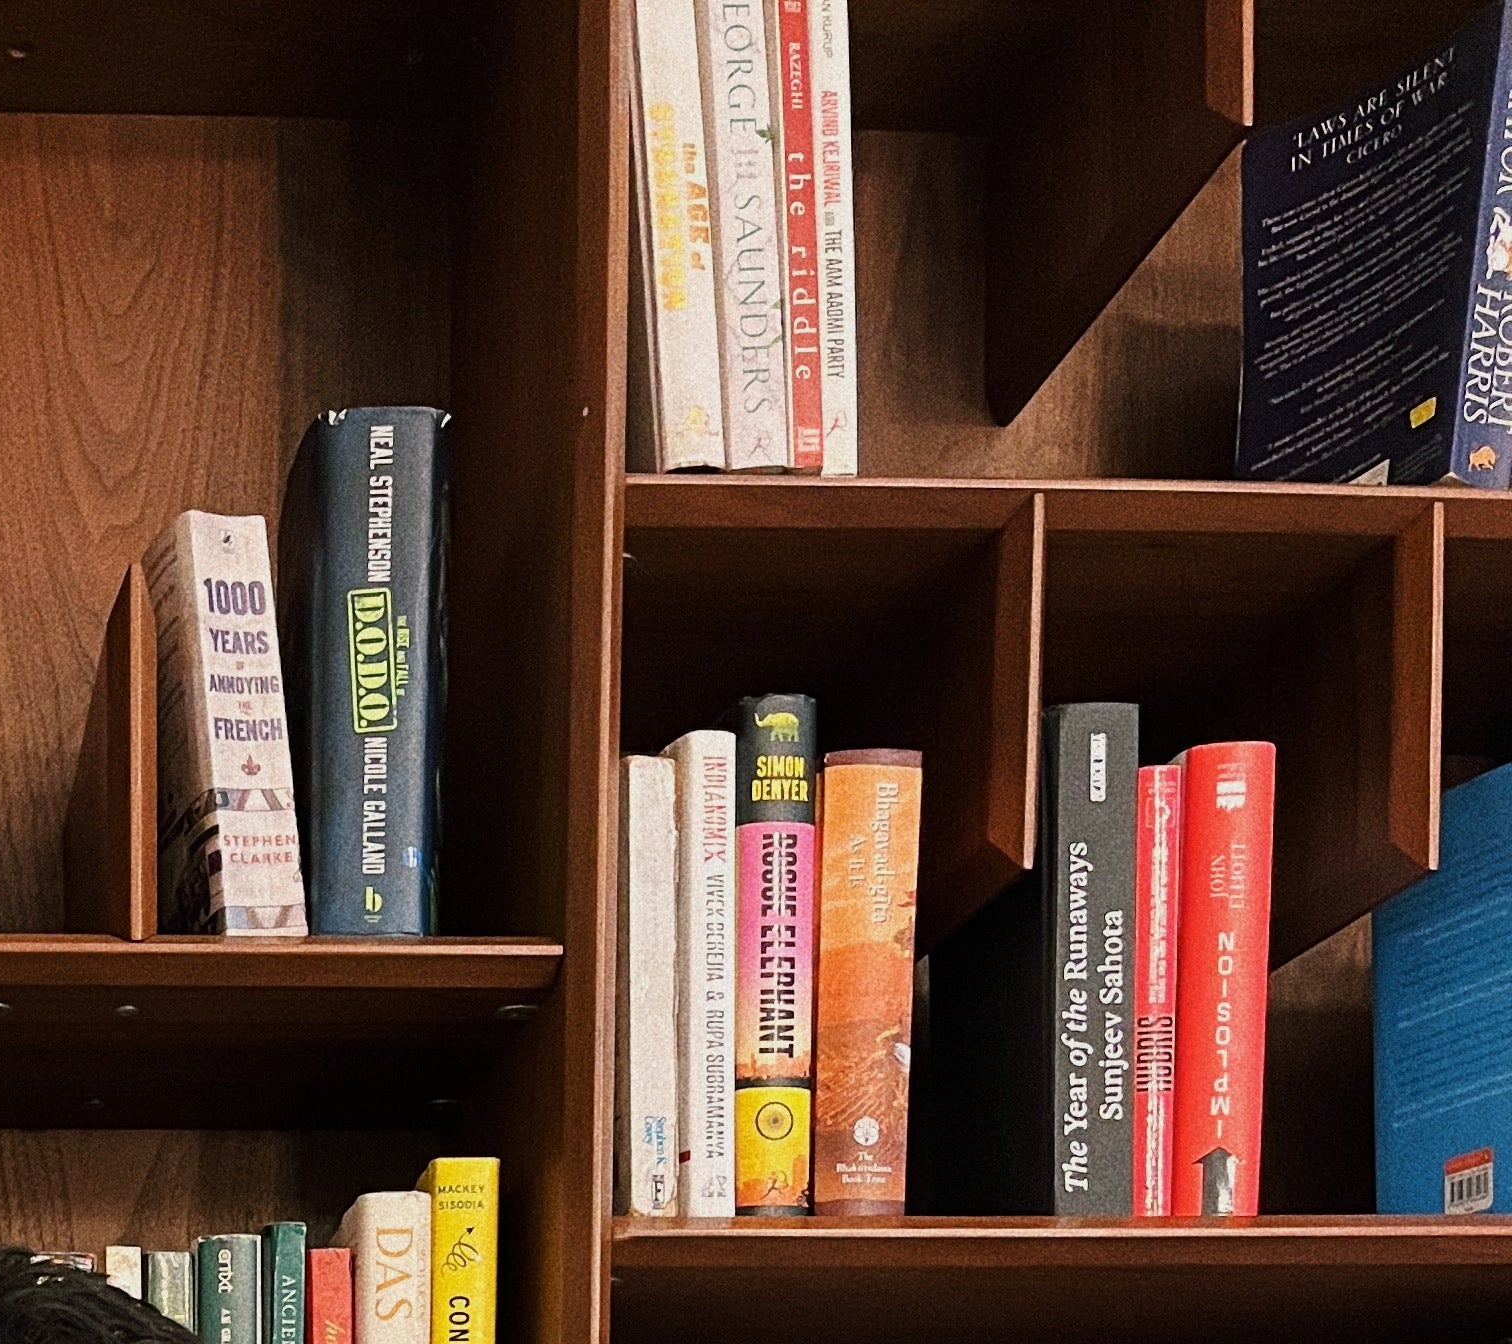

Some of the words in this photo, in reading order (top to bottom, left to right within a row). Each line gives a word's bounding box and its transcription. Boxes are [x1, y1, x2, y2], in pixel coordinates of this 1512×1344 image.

[789, 42, 804, 110] RAZEGHI
[1291, 148, 1311, 173] IN
[1322, 120, 1375, 158] TIMES
[1380, 100, 1405, 126] OF
[789, 153, 806, 216] the
[734, 194, 773, 413] SAUNDERS
[793, 245, 818, 380] riddle
[1464, 285, 1492, 424] HARRIS
[370, 426, 394, 470] NEAL
[368, 475, 393, 582] STEPHENSON
[203, 577, 267, 616] 1000
[208, 628, 270, 654] YEARS
[208, 675, 279, 694] ANNOYING
[213, 717, 283, 742] FRENCH
[363, 737, 388, 794] NICOLE
[752, 779, 809, 801] DENYER
[756, 756, 804, 778] SIMON
[223, 834, 296, 846] STEPHEN
[230, 852, 294, 863] CLARKE
[362, 799, 386, 875] GALLAND
[1063, 842, 1093, 981] Runaways
[1098, 910, 1123, 1005] Sahota
[1064, 1002, 1088, 1035] the
[1210, 932, 1234, 1139] IMPLOSION
[1062, 1037, 1093, 1065] of
[1099, 1015, 1129, 1121] Sunjeev
[1064, 1076, 1087, 1137] Year
[437, 1183, 485, 1195] MACKEY
[1064, 1142, 1088, 1192] The
[376, 1226, 411, 1321] DAS
